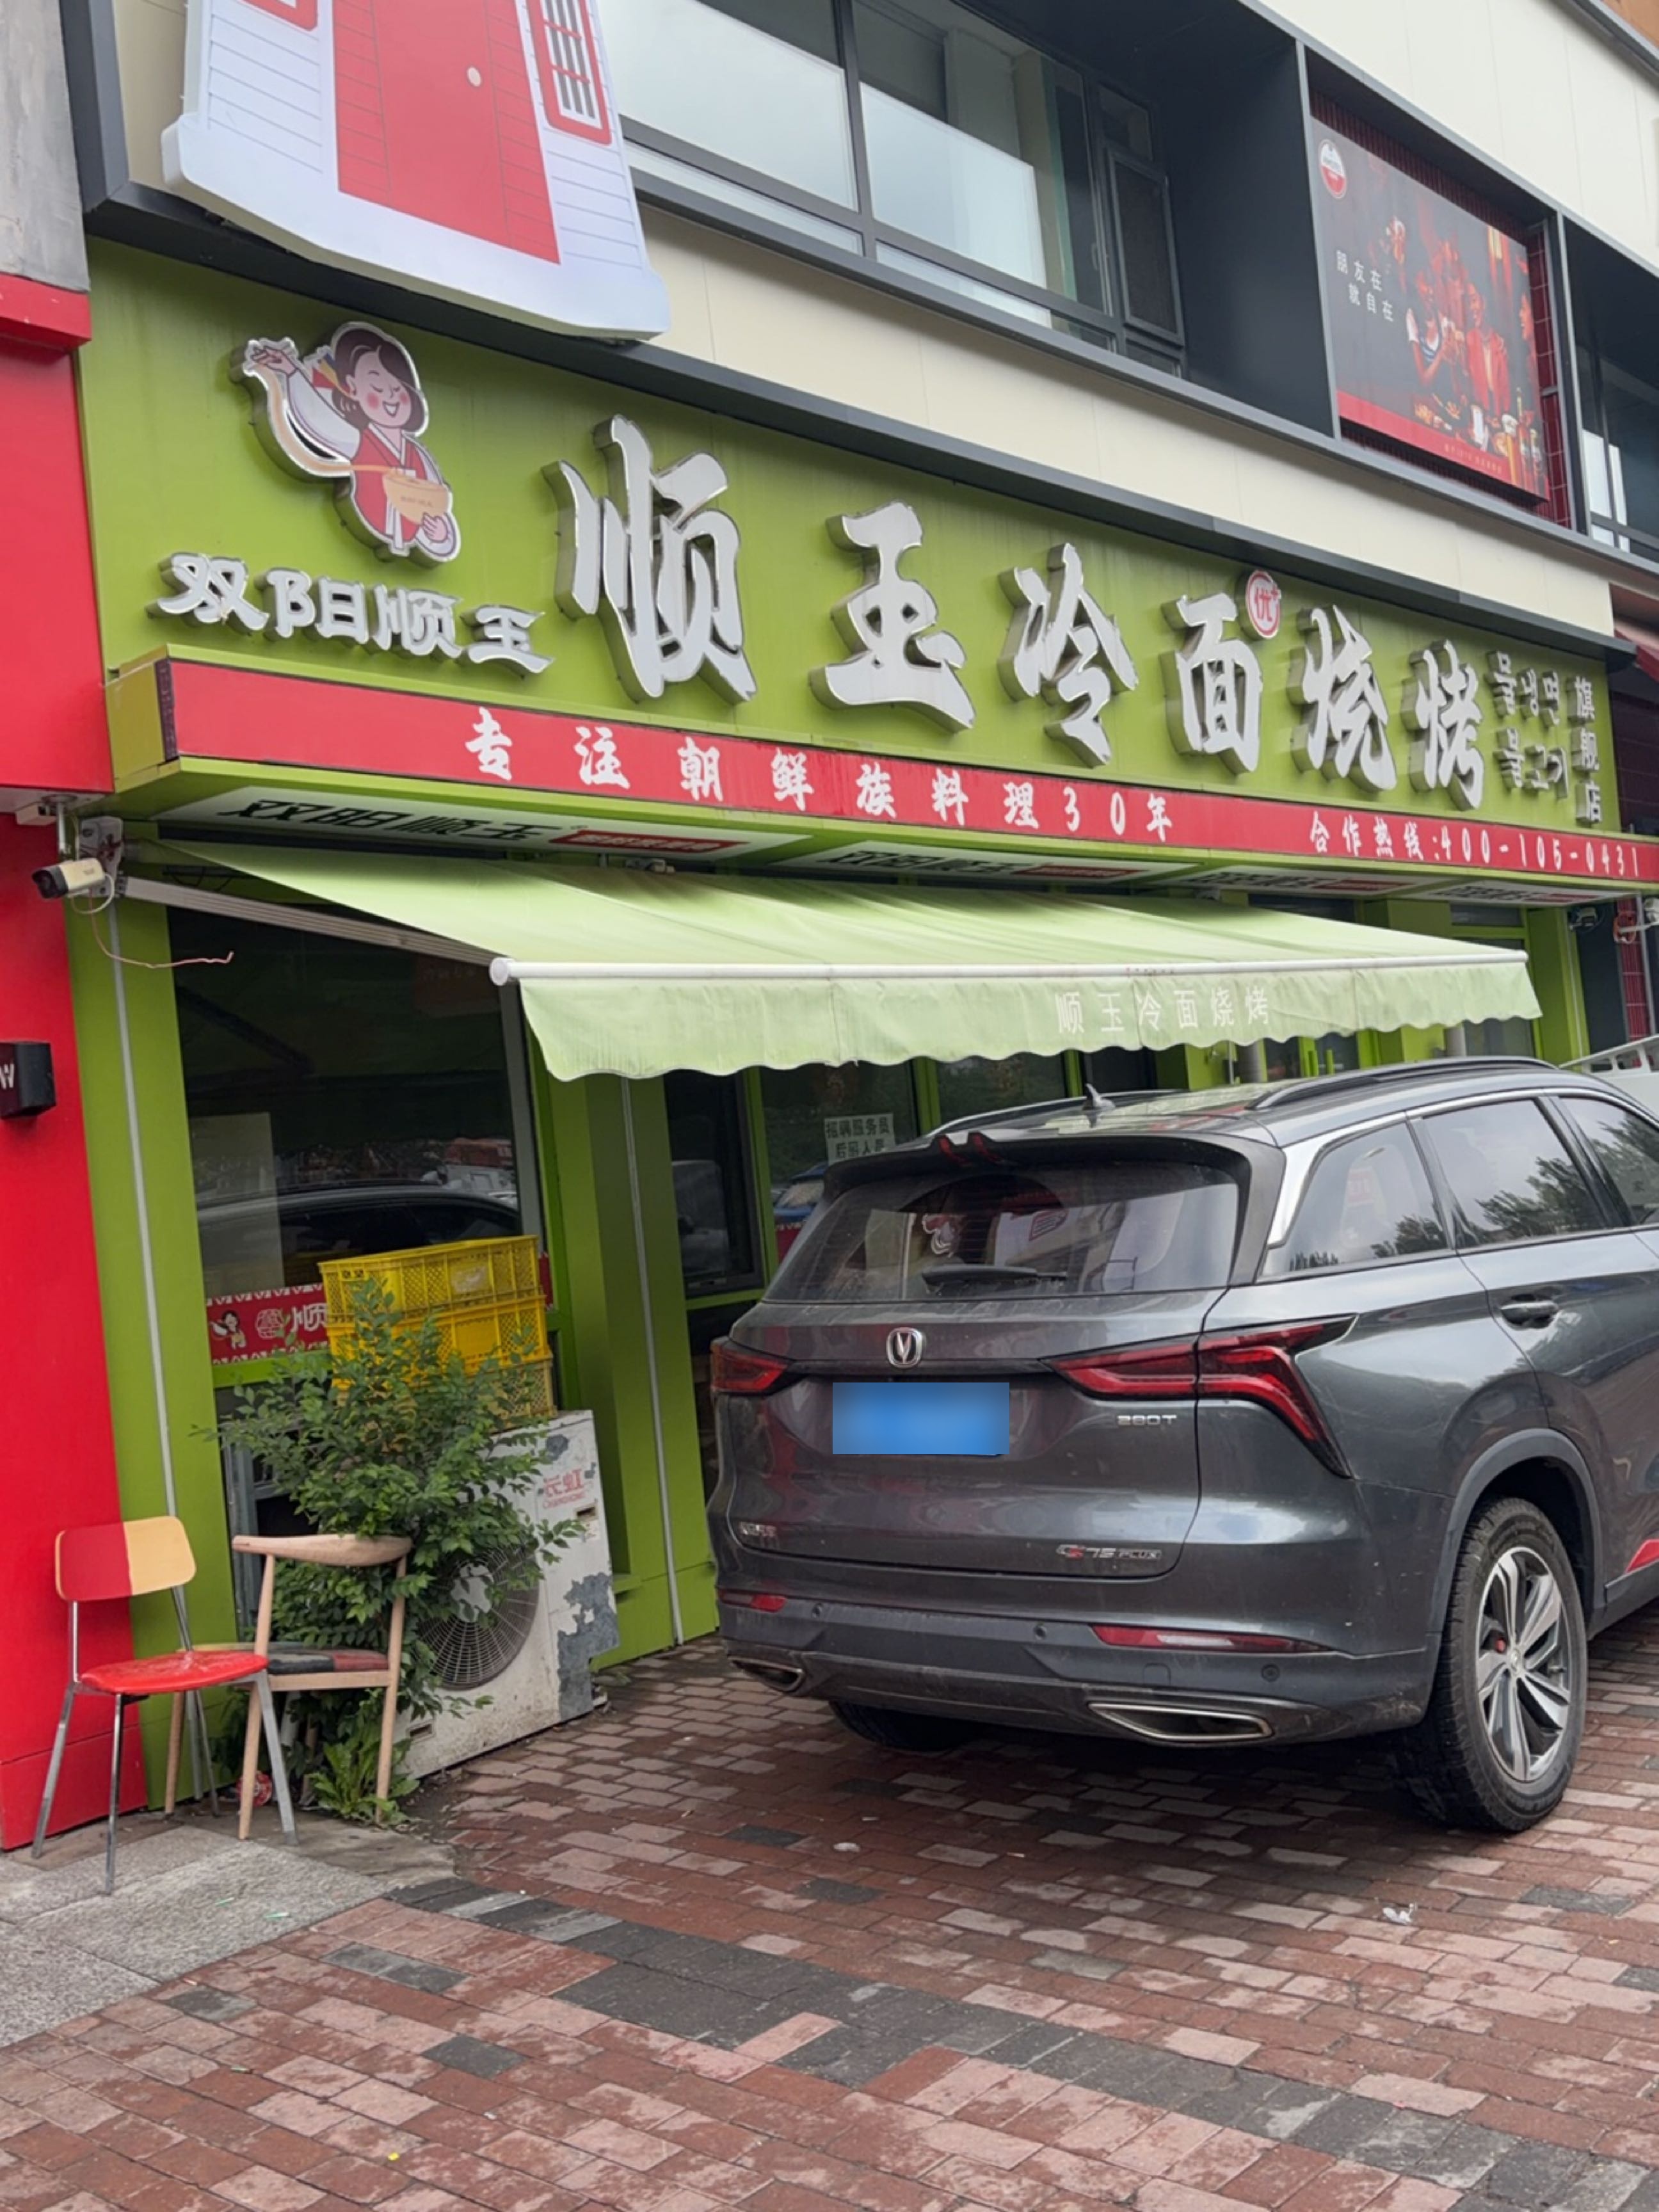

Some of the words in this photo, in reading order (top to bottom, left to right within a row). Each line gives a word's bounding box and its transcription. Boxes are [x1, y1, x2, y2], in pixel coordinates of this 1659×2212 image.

[558, 413, 1484, 810] 顺玉冷面烧烤
[465, 706, 1172, 842] 专注朝鲜族料理30年
[1055, 986, 1269, 1034] 顺玉冷面烧烤
